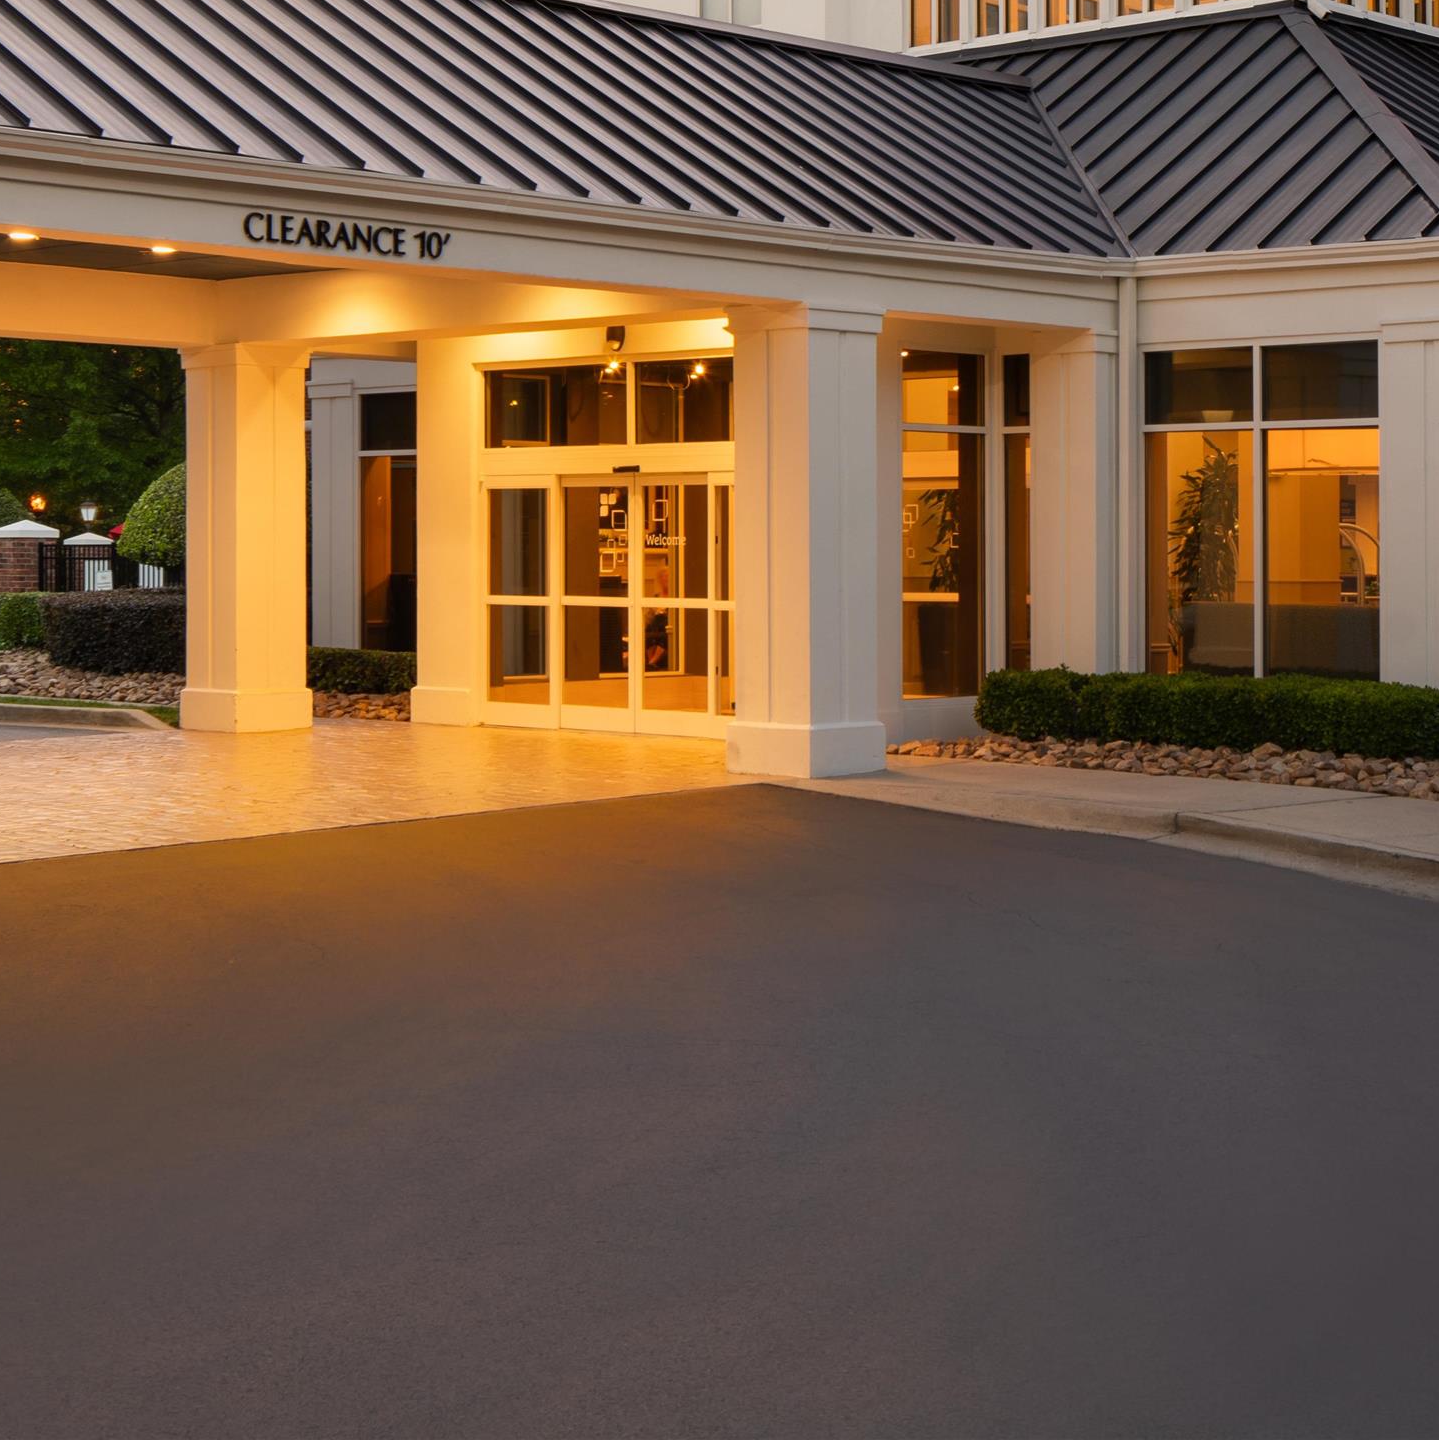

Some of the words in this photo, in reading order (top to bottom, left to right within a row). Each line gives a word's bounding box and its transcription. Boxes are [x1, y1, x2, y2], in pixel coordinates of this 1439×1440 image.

[242, 211, 406, 256] CLEARANCE
[413, 230, 451, 260] 10'
[645, 533, 687, 546] Welcome
